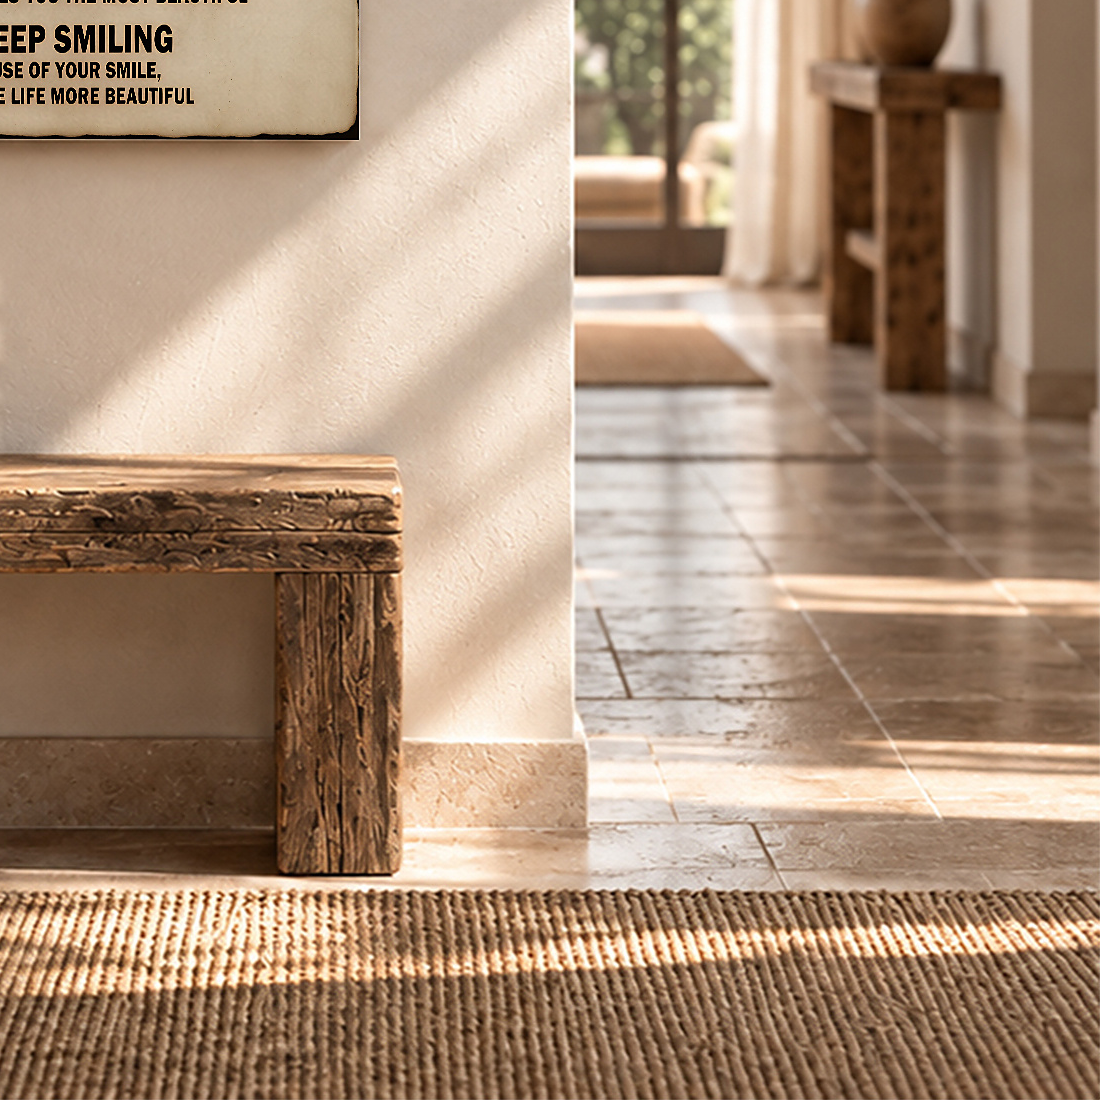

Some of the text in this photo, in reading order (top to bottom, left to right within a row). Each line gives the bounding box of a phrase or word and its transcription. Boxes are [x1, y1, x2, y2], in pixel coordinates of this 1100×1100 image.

[53, 24, 173, 54] SMILING
[28, 61, 51, 79] OF
[54, 61, 101, 79] YOUR
[105, 61, 162, 83] SMILE,
[11, 87, 46, 105] LIFE
[50, 86, 100, 105] MORE
[105, 87, 195, 105] BEAUTIFUL
